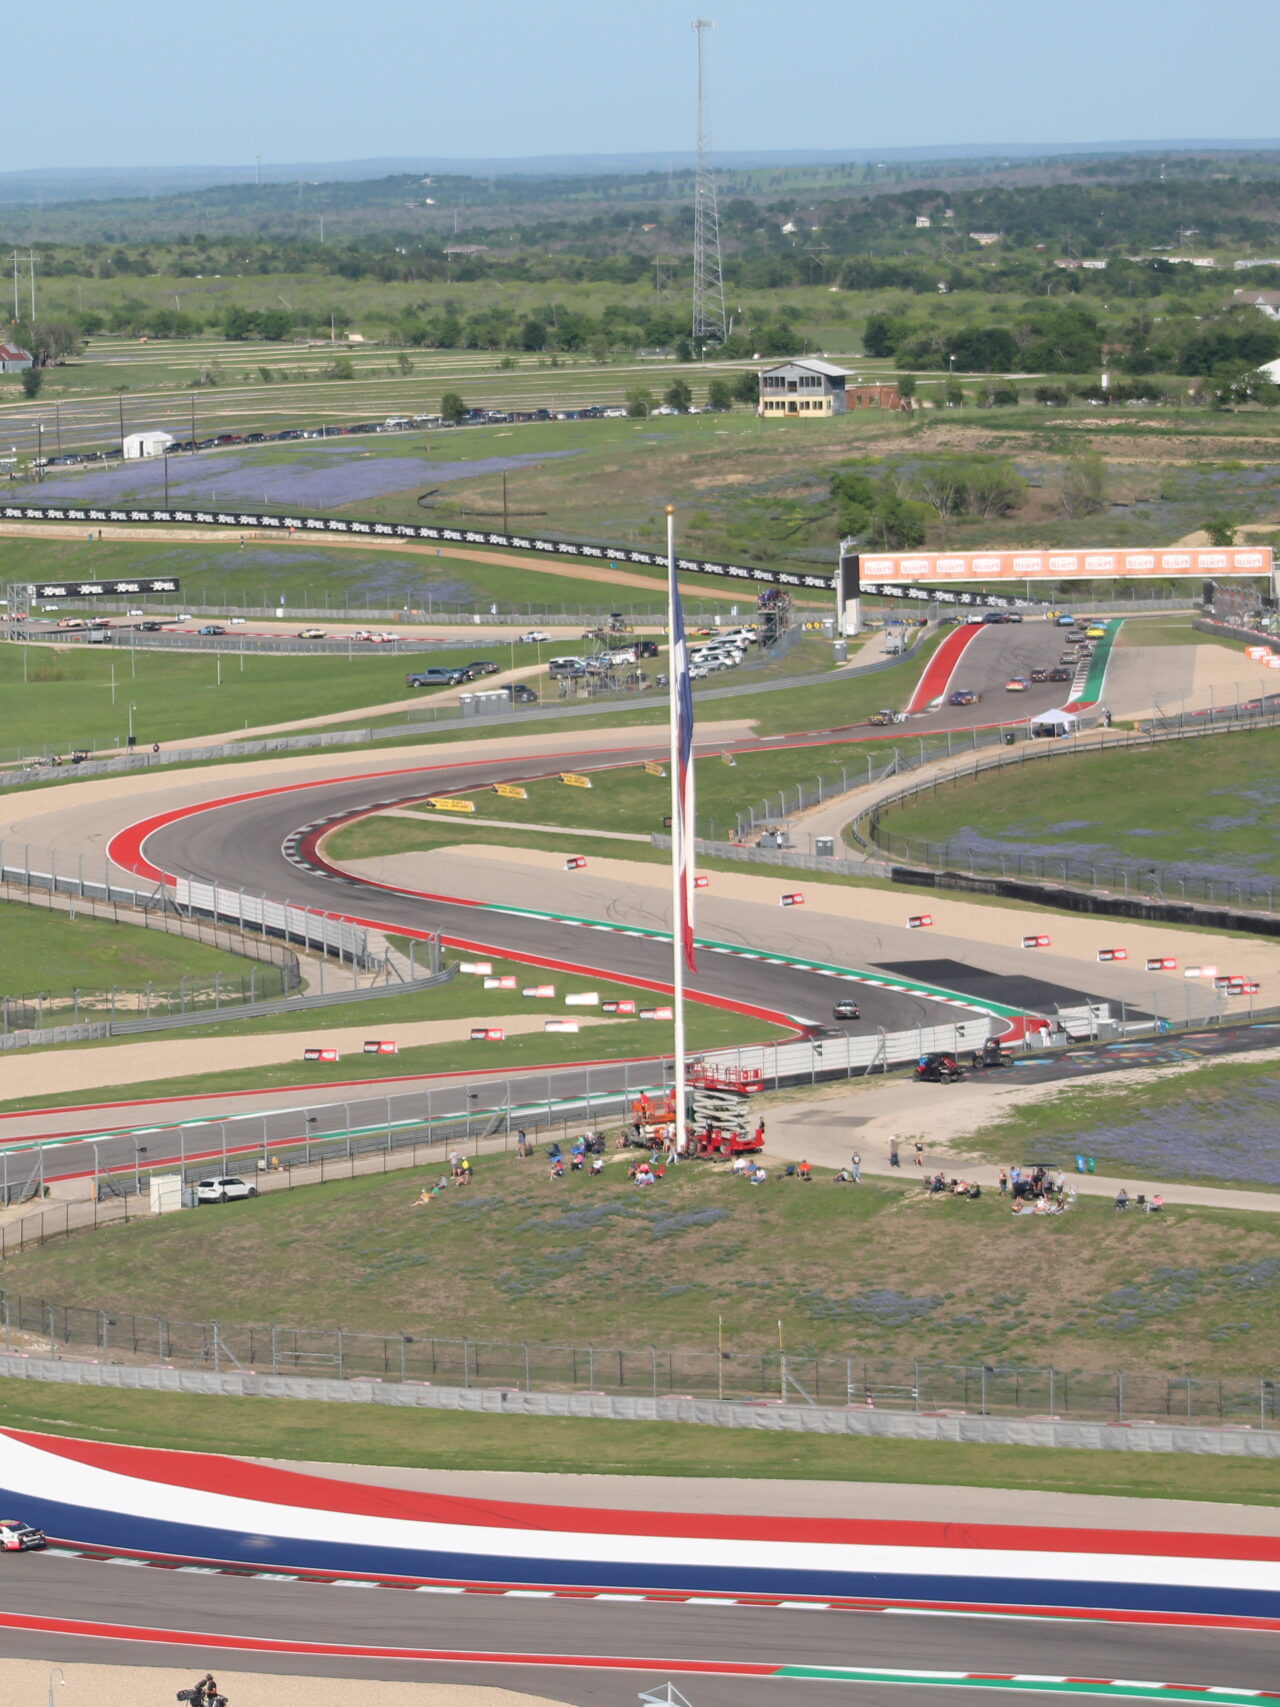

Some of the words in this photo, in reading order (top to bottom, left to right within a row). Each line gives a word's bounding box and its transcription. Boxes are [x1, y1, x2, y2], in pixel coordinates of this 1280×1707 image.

[4, 508, 22, 517] XPEL
[25, 510, 43, 518] XPEL
[46, 510, 64, 518] XPEL
[67, 510, 85, 518] XPEL
[88, 511, 106, 519] XPEL
[108, 512, 127, 520] XPEL
[129, 512, 149, 520] XPEL
[152, 512, 170, 520] XPEL
[173, 512, 192, 521] XPEL
[194, 513, 213, 522] XPEL
[216, 515, 235, 523] XPEL
[238, 516, 257, 524] XPEL
[260, 517, 280, 526] XPEL
[282, 518, 302, 528] XPEL
[304, 519, 325, 528] XPEL
[327, 521, 347, 530] XPEL
[349, 523, 370, 532] XPEL
[373, 524, 393, 533] XPEL
[418, 528, 438, 537] XPEL
[441, 530, 462, 540] XPEL
[464, 532, 485, 542] XPEL
[487, 535, 508, 545] XPEL
[510, 538, 531, 548] XPEL
[533, 541, 554, 550] XPEL
[556, 544, 577, 553] XPEL
[580, 547, 602, 556] XPEL
[604, 549, 626, 559] XPEL
[629, 552, 650, 563] XPEL
[676, 560, 698, 570] XPEL
[701, 564, 723, 573] XPEL
[726, 567, 749, 577] XPEL
[751, 570, 774, 580] XPEL
[776, 574, 799, 584] XPEL
[802, 577, 825, 587] XPEL
[880, 586, 902, 596] XPEL
[906, 589, 928, 599] XPEL
[932, 591, 955, 602] XPEL
[984, 596, 1008, 607] XPEL
[41, 586, 66, 596] XPEL
[78, 585, 104, 594] XPEL
[114, 583, 139, 593] XPEL
[150, 581, 176, 591] XPEL
